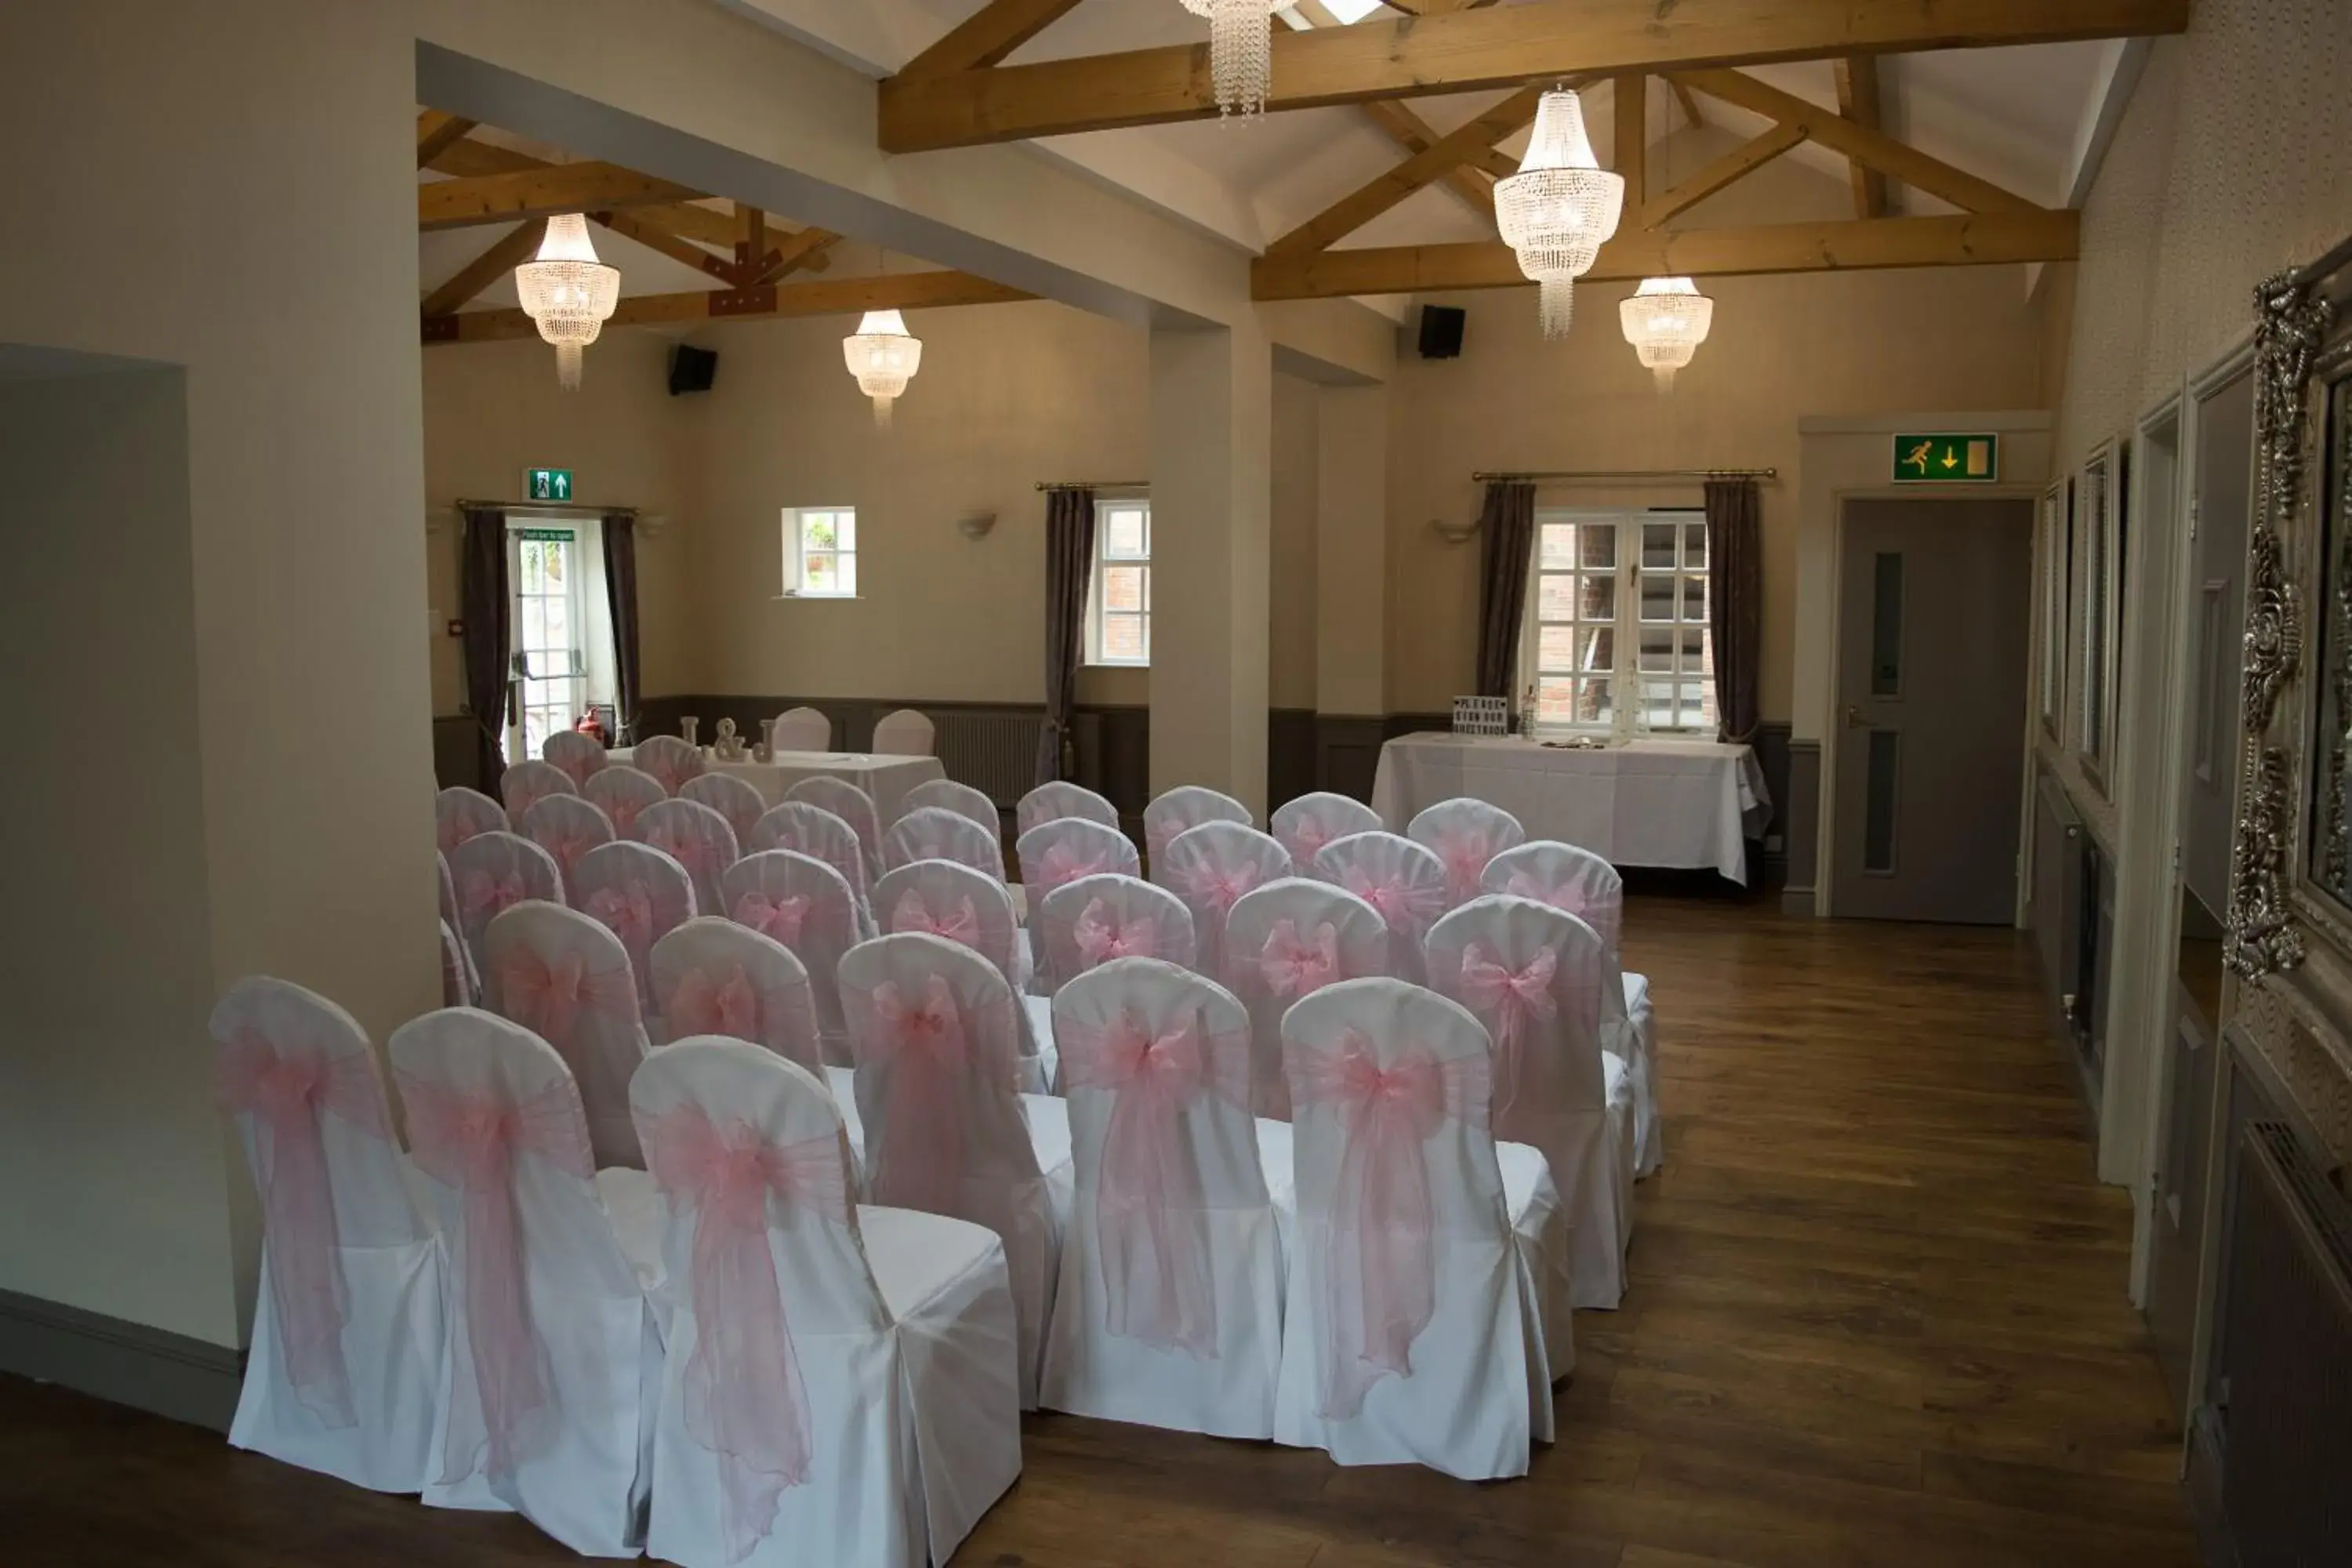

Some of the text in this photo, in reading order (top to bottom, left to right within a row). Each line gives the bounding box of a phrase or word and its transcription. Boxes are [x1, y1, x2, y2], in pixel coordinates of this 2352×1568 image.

[1460, 699, 1501, 710] PLEASE
[1456, 711, 1504, 722] SIGN OUR
[714, 717, 746, 763] &
